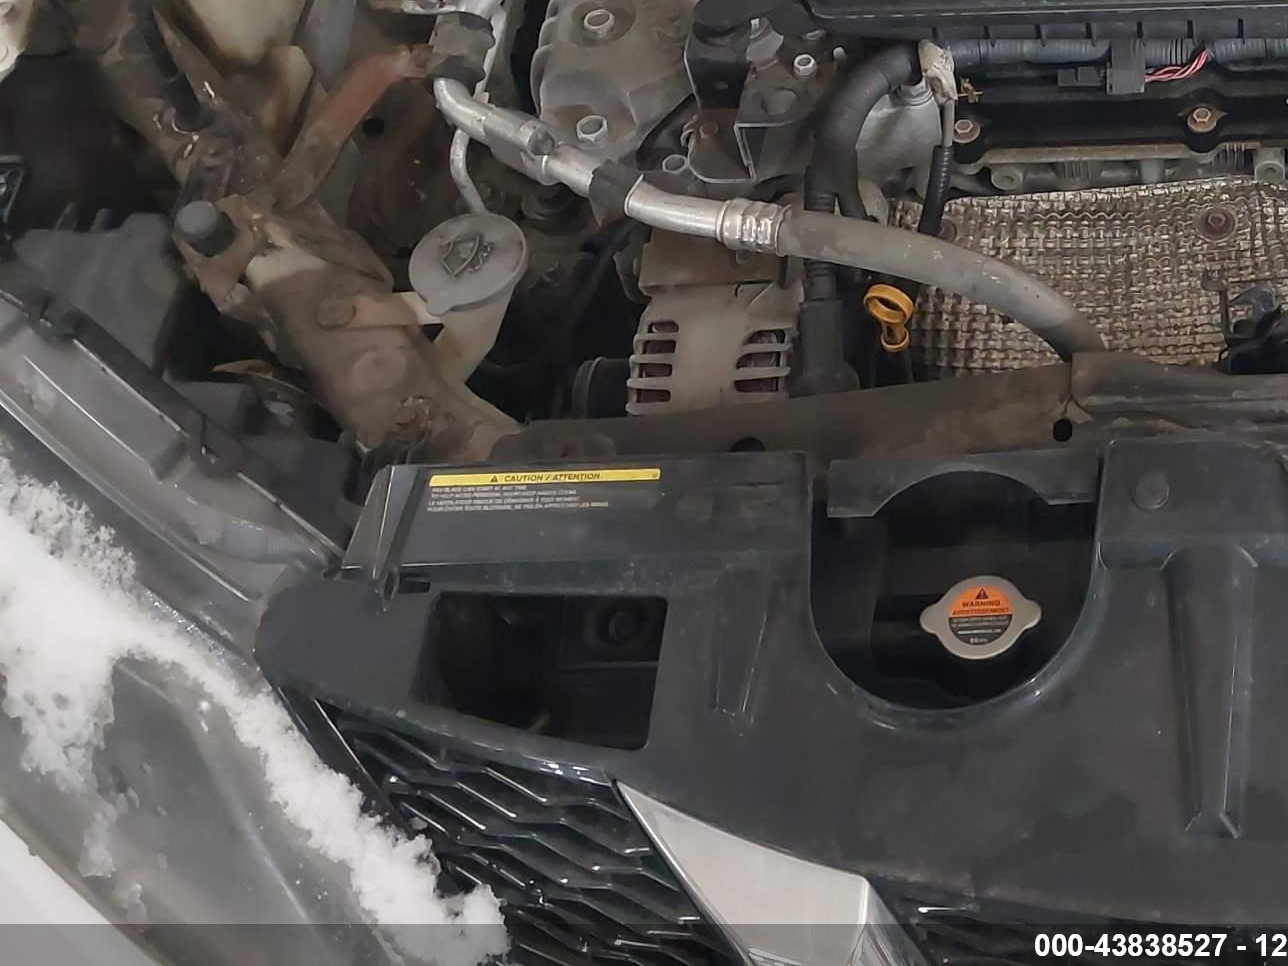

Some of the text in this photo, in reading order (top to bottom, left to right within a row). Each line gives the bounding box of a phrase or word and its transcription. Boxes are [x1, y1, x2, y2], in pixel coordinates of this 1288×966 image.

[504, 474, 543, 482] CAUTION
[551, 472, 601, 480] ATTENTION
[962, 600, 1001, 608] WARNING
